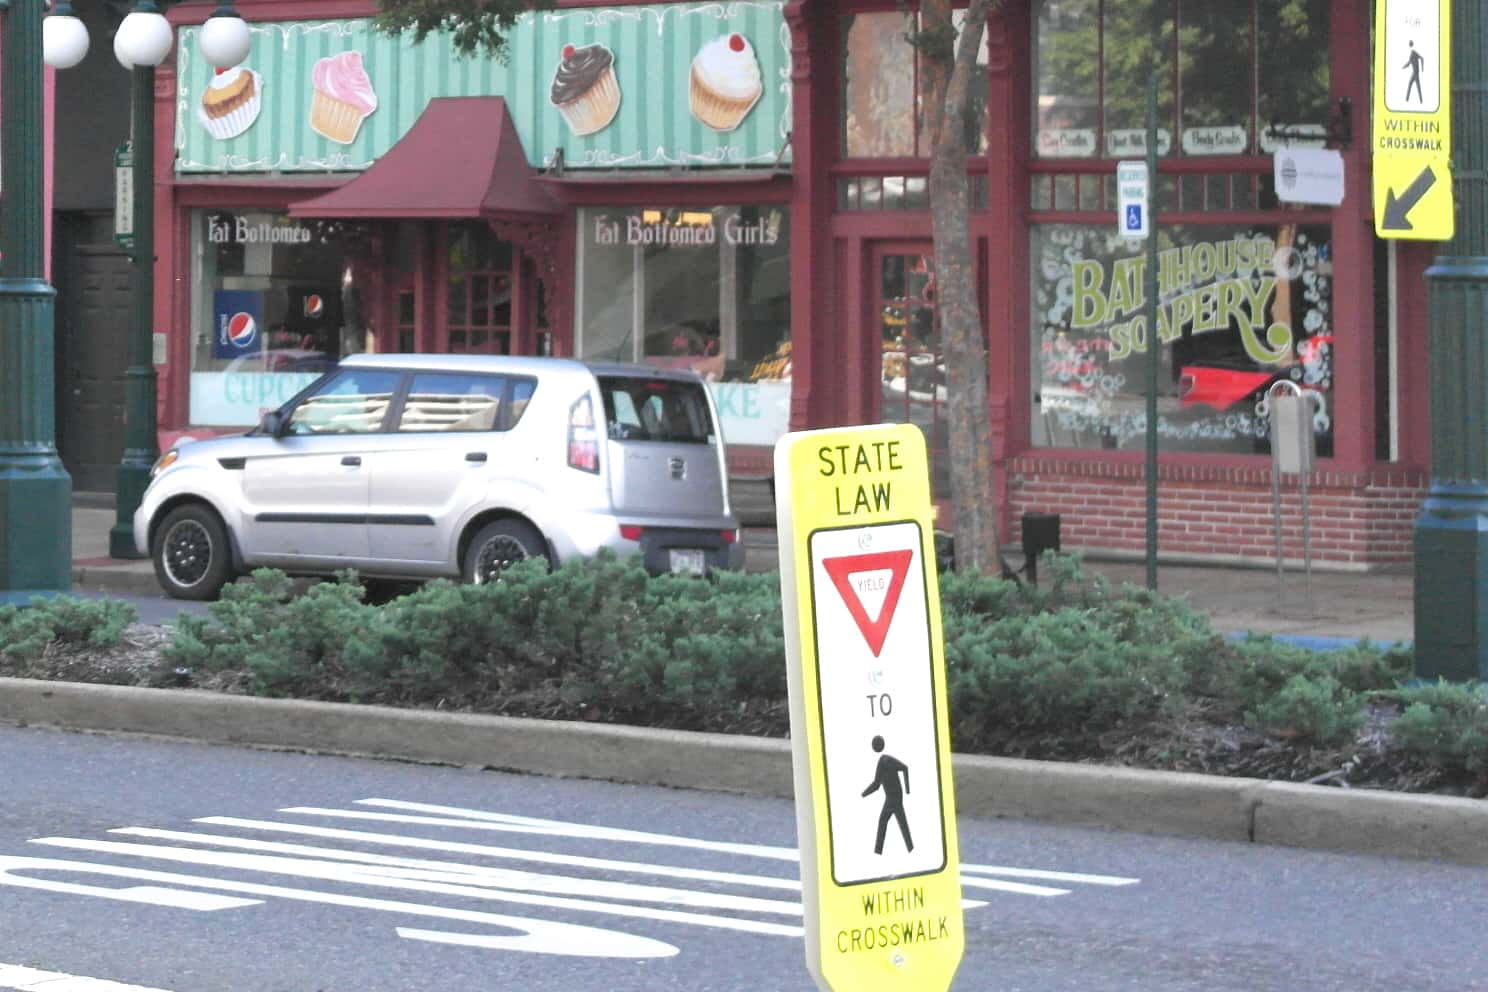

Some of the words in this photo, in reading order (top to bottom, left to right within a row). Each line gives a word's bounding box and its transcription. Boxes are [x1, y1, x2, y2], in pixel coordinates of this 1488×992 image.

[1384, 119, 1440, 134] WITHIN
[1379, 136, 1442, 151] CROSSWALK
[207, 215, 230, 243] Fat
[593, 214, 620, 245] Fat
[818, 440, 903, 477] STATE
[835, 481, 891, 516] LAW
[857, 577, 886, 593] YIELD
[866, 693, 893, 718] TO
[862, 887, 925, 917] WITHIN
[837, 916, 949, 953] CROSSWALK
